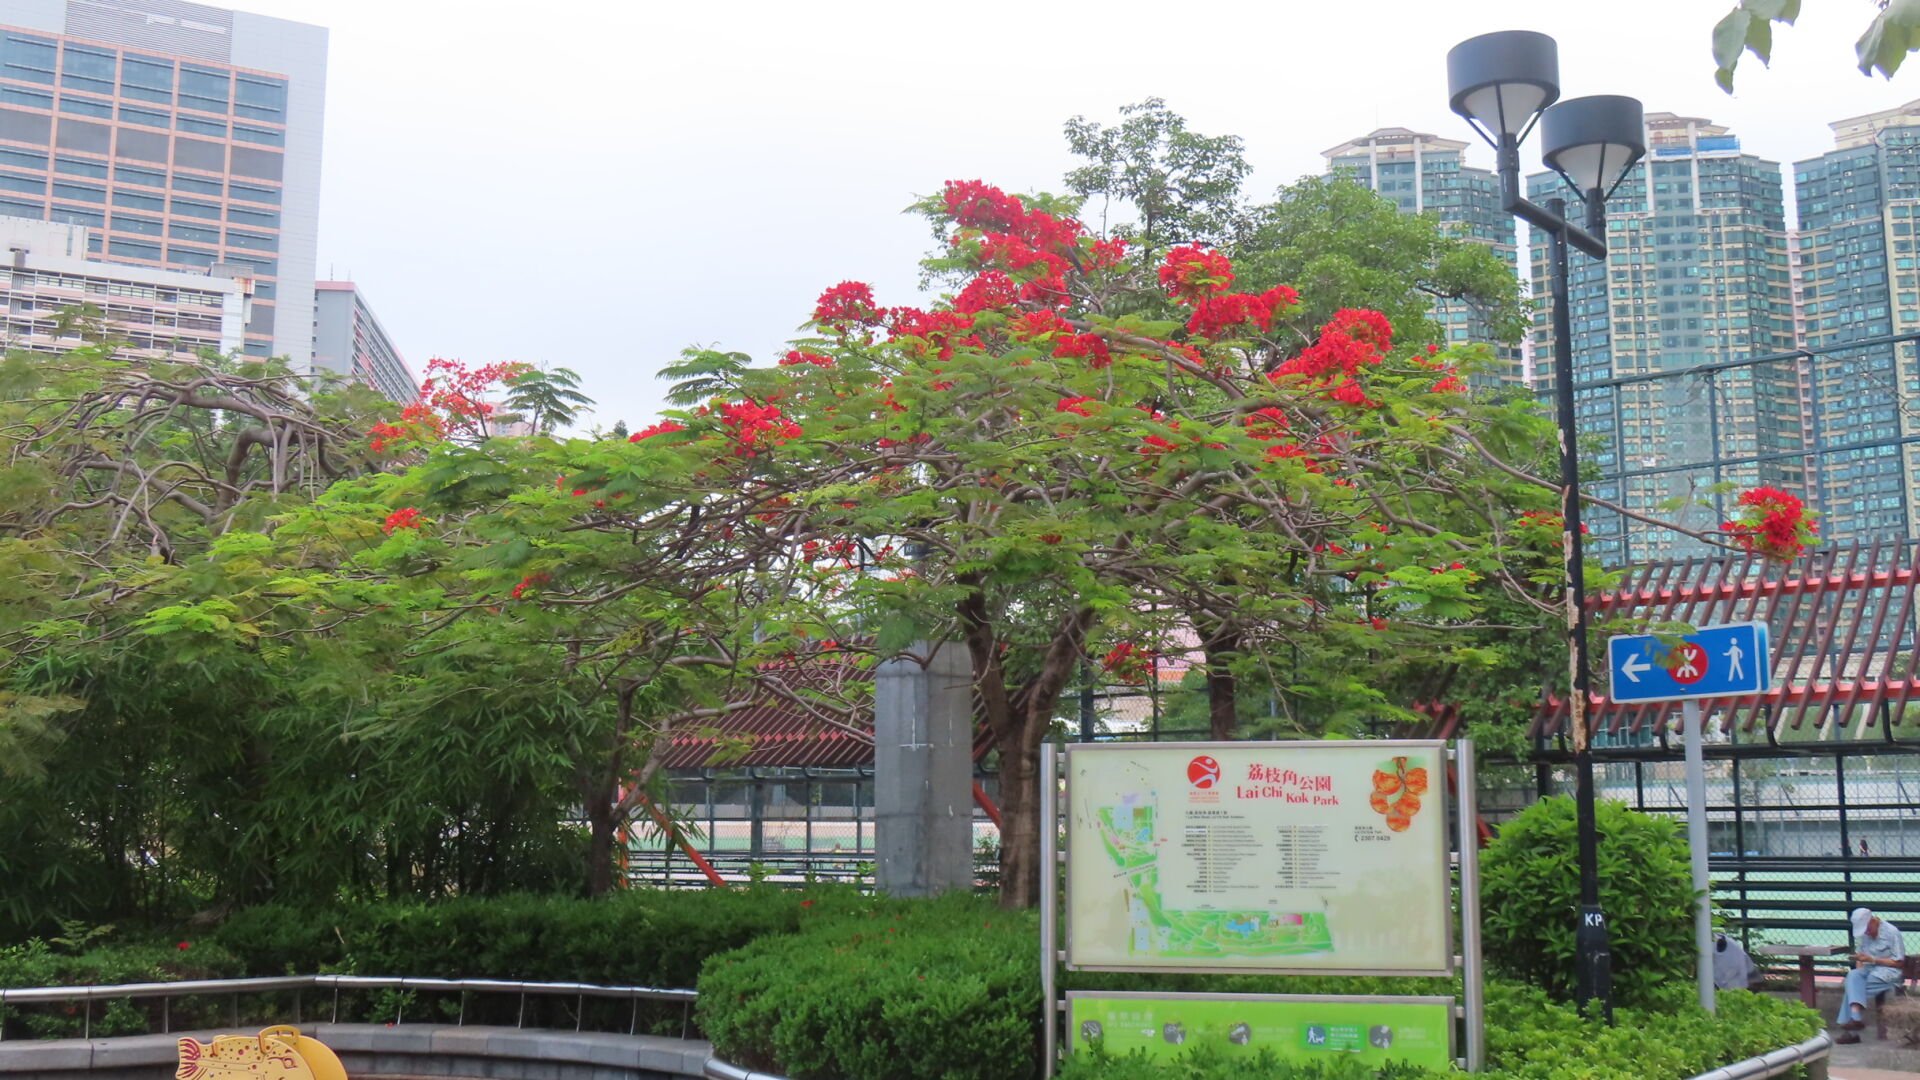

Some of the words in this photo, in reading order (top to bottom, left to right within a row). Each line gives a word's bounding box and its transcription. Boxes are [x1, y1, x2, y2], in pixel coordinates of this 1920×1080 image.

[1248, 763, 1331, 792] 荔枝角公園
[1236, 785, 1259, 799] Lai
[1262, 785, 1283, 798] Chi
[1286, 793, 1309, 804] Kok
[1313, 796, 1339, 806] Park
[1584, 912, 1603, 927] KP
